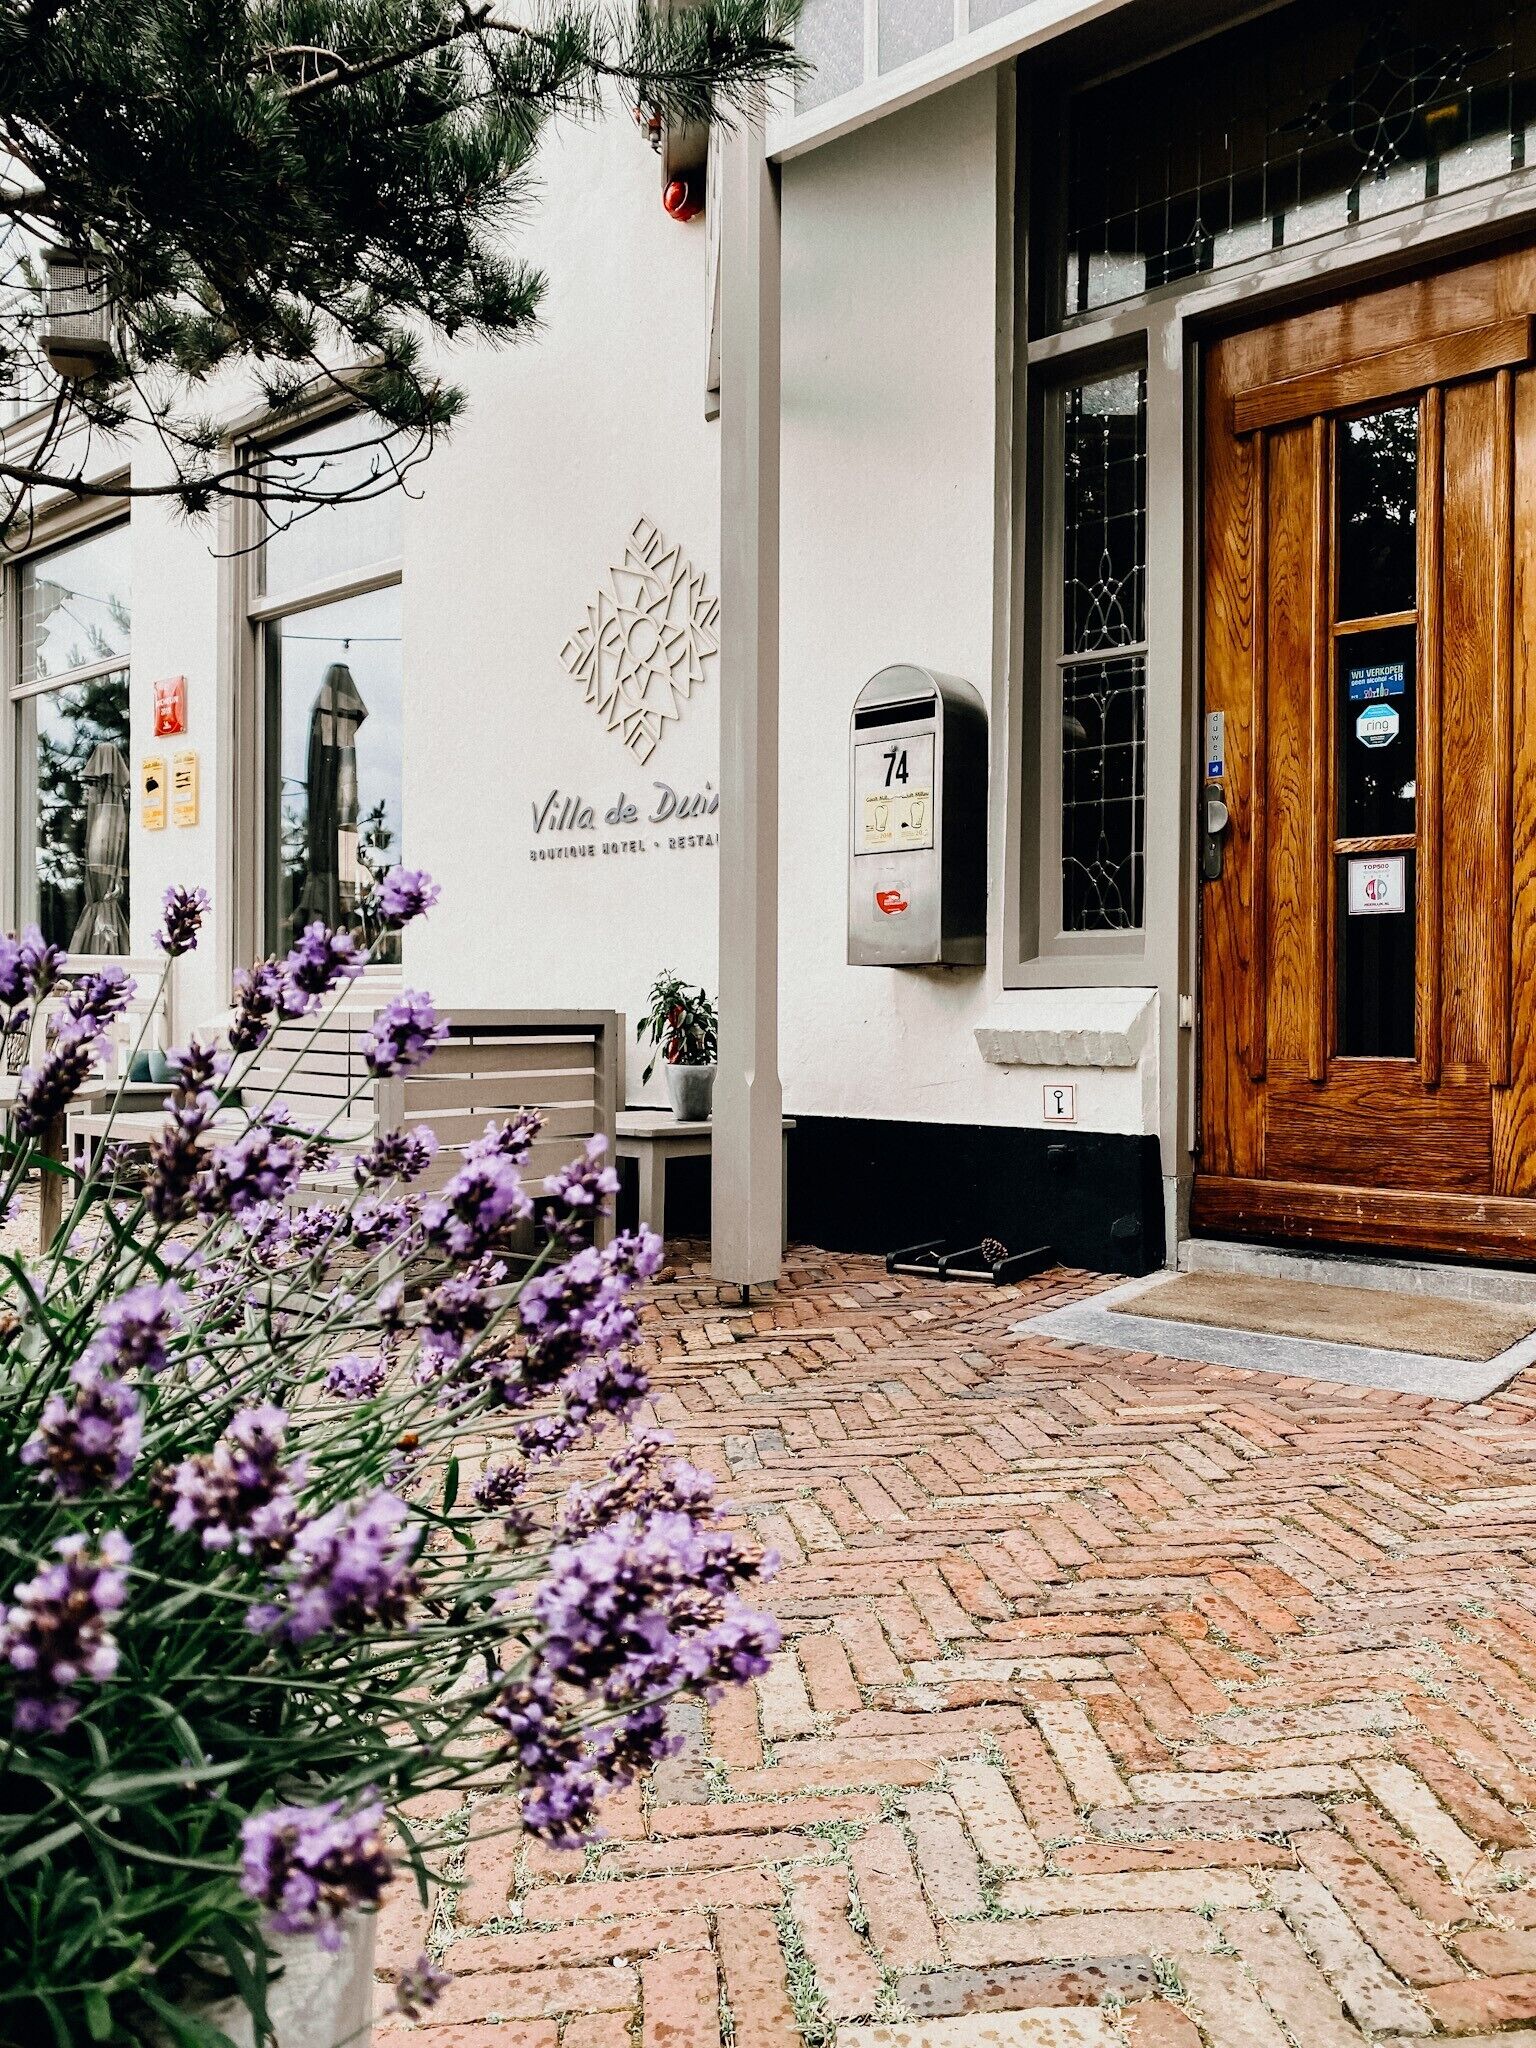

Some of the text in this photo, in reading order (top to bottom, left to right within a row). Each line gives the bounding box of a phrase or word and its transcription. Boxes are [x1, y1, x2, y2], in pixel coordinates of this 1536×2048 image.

[1366, 665, 1403, 677] VERKOPEN
[1366, 720, 1389, 732] ring
[883, 750, 909, 787] 74
[531, 789, 595, 833] Villa
[604, 792, 638, 825] de
[529, 844, 595, 861] BOUTIQUE
[602, 840, 646, 855] HOTEL
